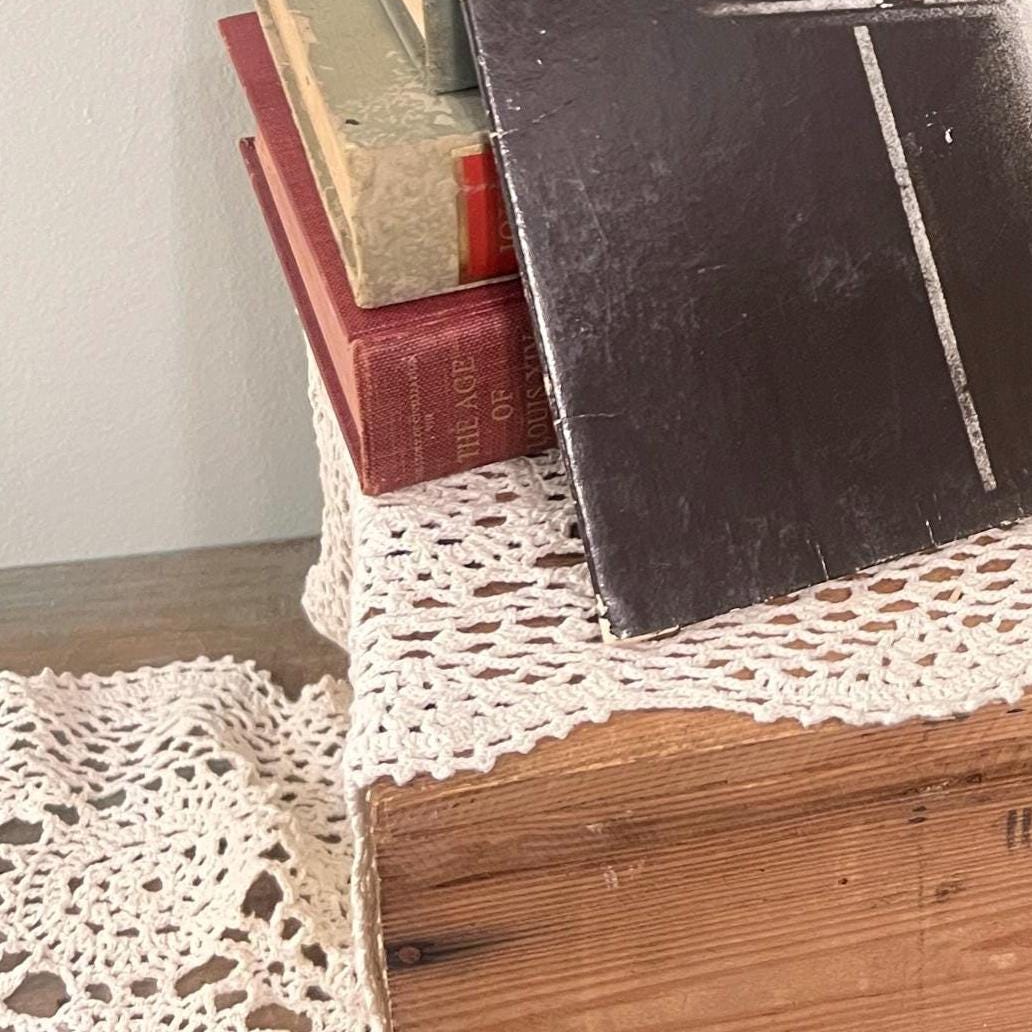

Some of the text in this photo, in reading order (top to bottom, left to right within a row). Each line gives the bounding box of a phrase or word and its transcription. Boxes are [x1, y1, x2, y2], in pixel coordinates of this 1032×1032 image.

[452, 355, 481, 463] THE AGE
[491, 390, 513, 421] OF
[525, 386, 551, 451] LOUIS
